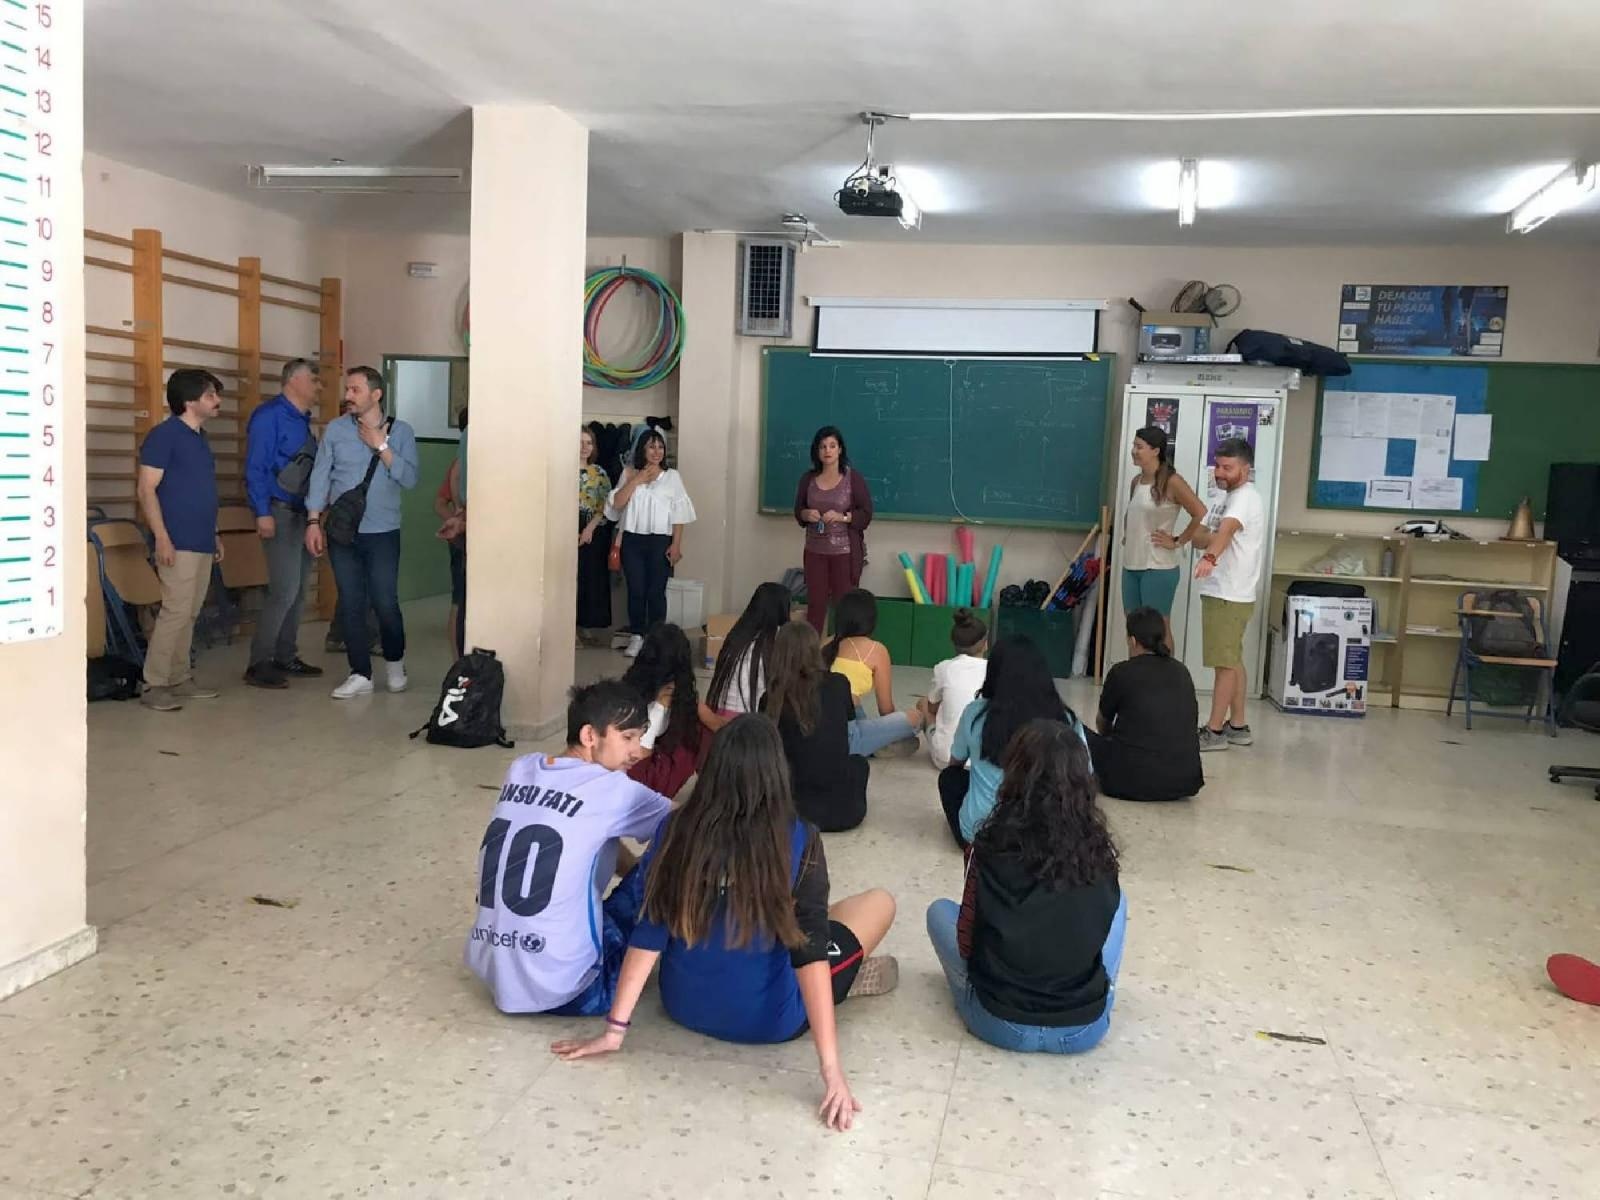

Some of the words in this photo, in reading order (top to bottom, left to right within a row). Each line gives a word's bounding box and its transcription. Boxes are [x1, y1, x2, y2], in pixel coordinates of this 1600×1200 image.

[35, 3, 52, 28] 15
[35, 46, 52, 70] 14
[35, 89, 52, 114] 13
[34, 131, 52, 156] 12
[37, 175, 52, 199] 11
[35, 217, 53, 241] 10
[41, 260, 54, 282] 9
[1377, 302, 1391, 313] TU
[1378, 290, 1406, 301] DEJA
[41, 301, 54, 325] 8
[42, 343, 54, 365] 7
[42, 425, 55, 447] 5
[42, 465, 55, 487] 4
[43, 506, 56, 528] 3
[43, 545, 56, 567] 2
[47, 586, 55, 607] 1
[538, 789, 584, 818] FATI
[479, 817, 563, 917] 10
[471, 924, 518, 949] unicef
